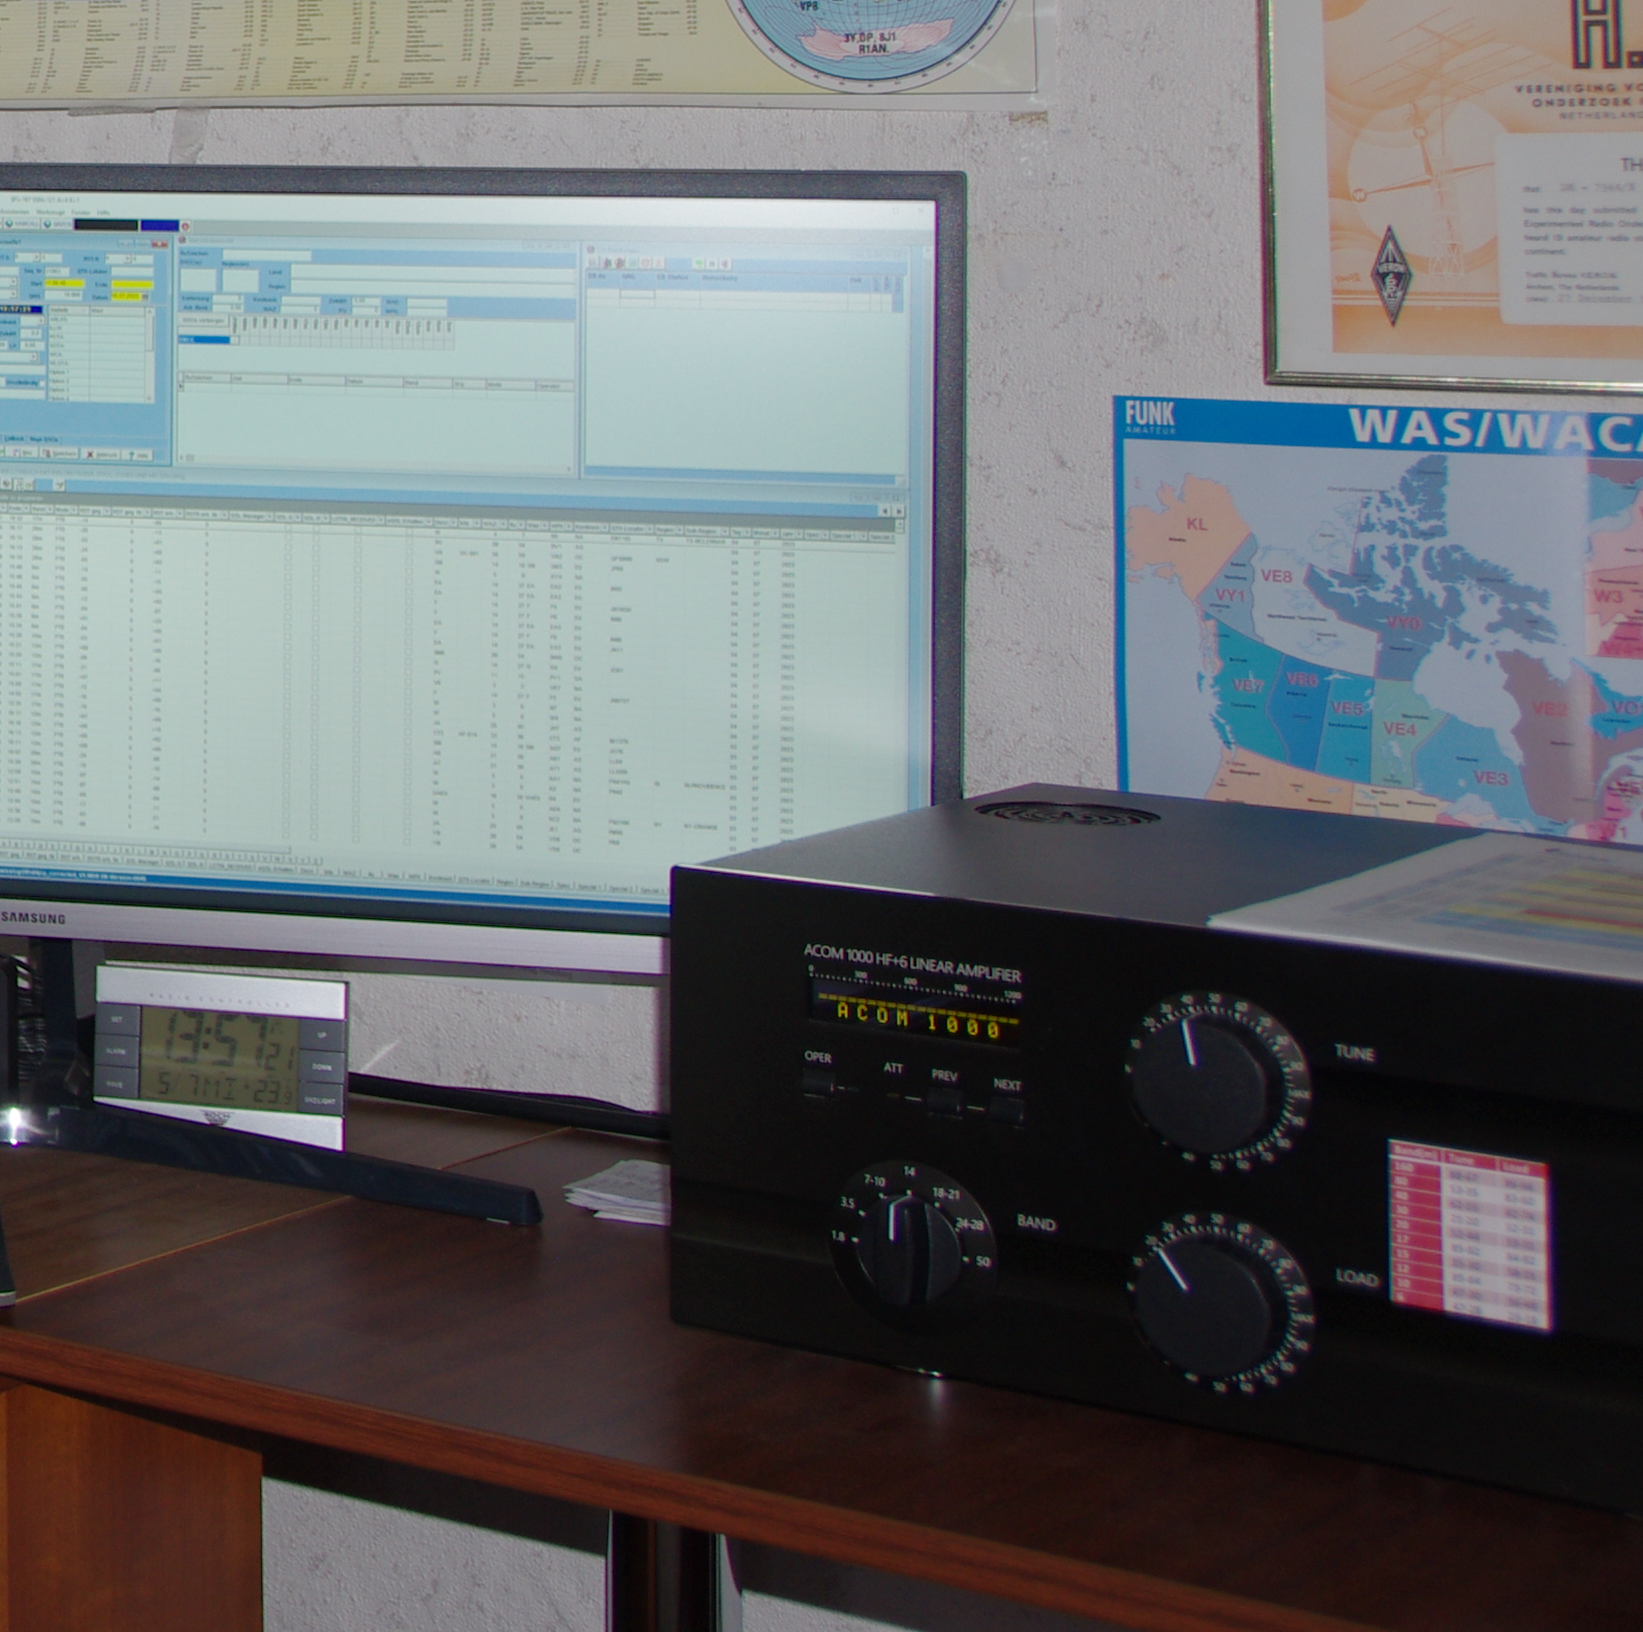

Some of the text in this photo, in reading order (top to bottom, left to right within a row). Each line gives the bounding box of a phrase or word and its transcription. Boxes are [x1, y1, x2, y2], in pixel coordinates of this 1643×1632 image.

[1515, 83, 1616, 94] VERENIGING
[1532, 98, 1632, 108] ONDERZOEK
[1126, 400, 1176, 427] FUNK
[1125, 426, 1176, 435] AMATEUR
[1349, 407, 1643, 452] WAS/WAC
[1186, 517, 1208, 532] KL
[1261, 568, 1293, 584] VE8
[1215, 588, 1245, 603] VY1
[1330, 701, 1363, 716] VE5
[1473, 771, 1509, 786] VE3
[0, 910, 66, 926] SAMSUNG
[804, 944, 1022, 983] ACOM 1000 HF+6 LINEAR AMPLIFIER
[837, 1002, 999, 1039] ACOM 1000
[804, 1051, 832, 1063] OPER
[1334, 1044, 1375, 1064] TUNE
[994, 1079, 1022, 1091] NEXT
[1017, 1214, 1057, 1231] BAND
[1334, 1268, 1379, 1288] LOAD
